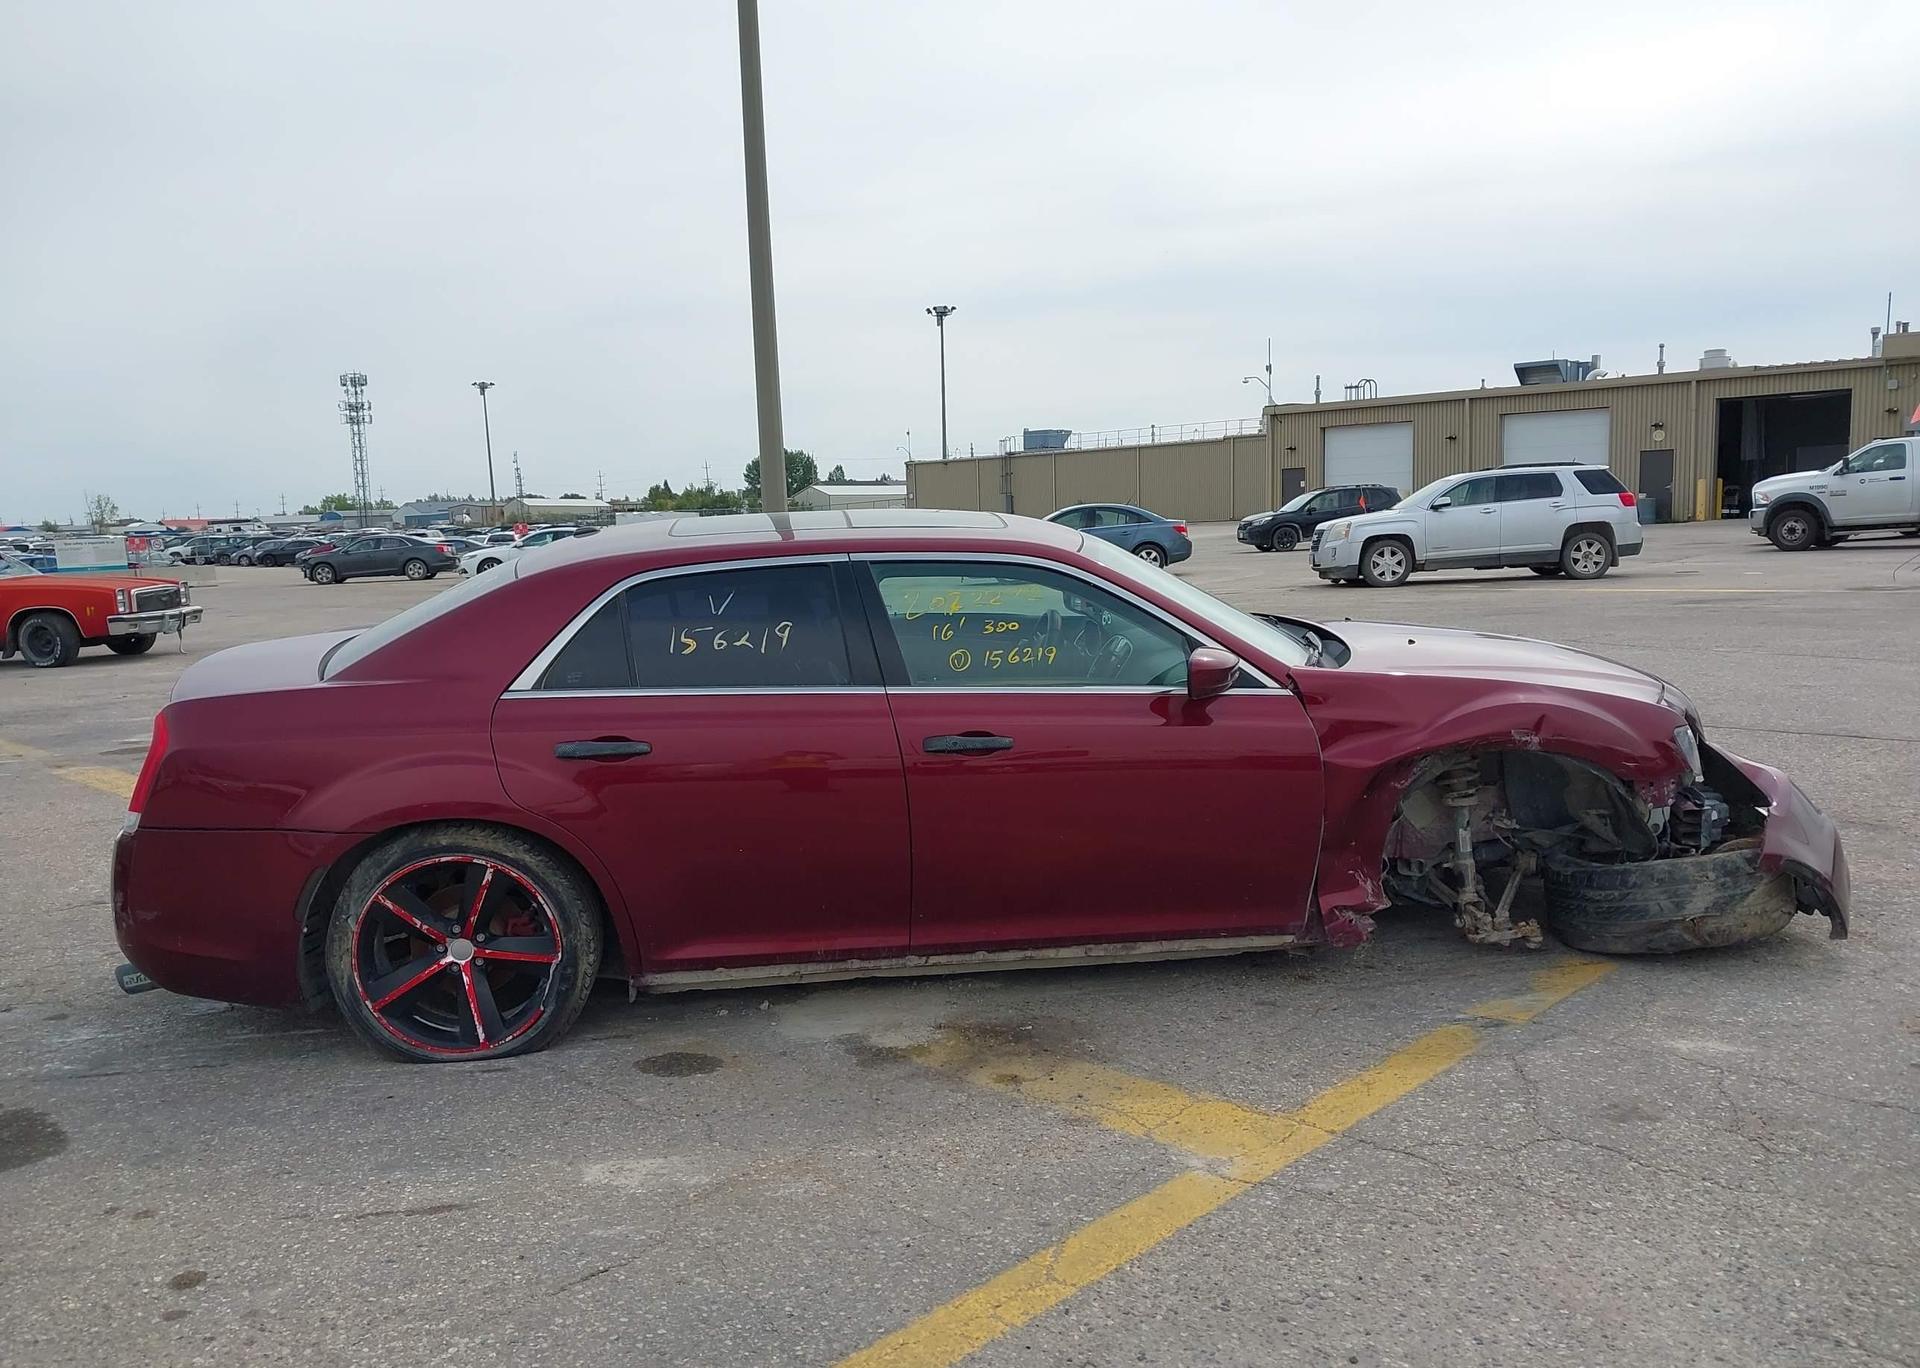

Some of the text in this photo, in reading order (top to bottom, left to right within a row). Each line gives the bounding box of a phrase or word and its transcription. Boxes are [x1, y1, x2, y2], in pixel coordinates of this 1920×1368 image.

[669, 620, 793, 656] 156219
[983, 618, 1021, 636] 300
[984, 646, 1058, 670] 156219
